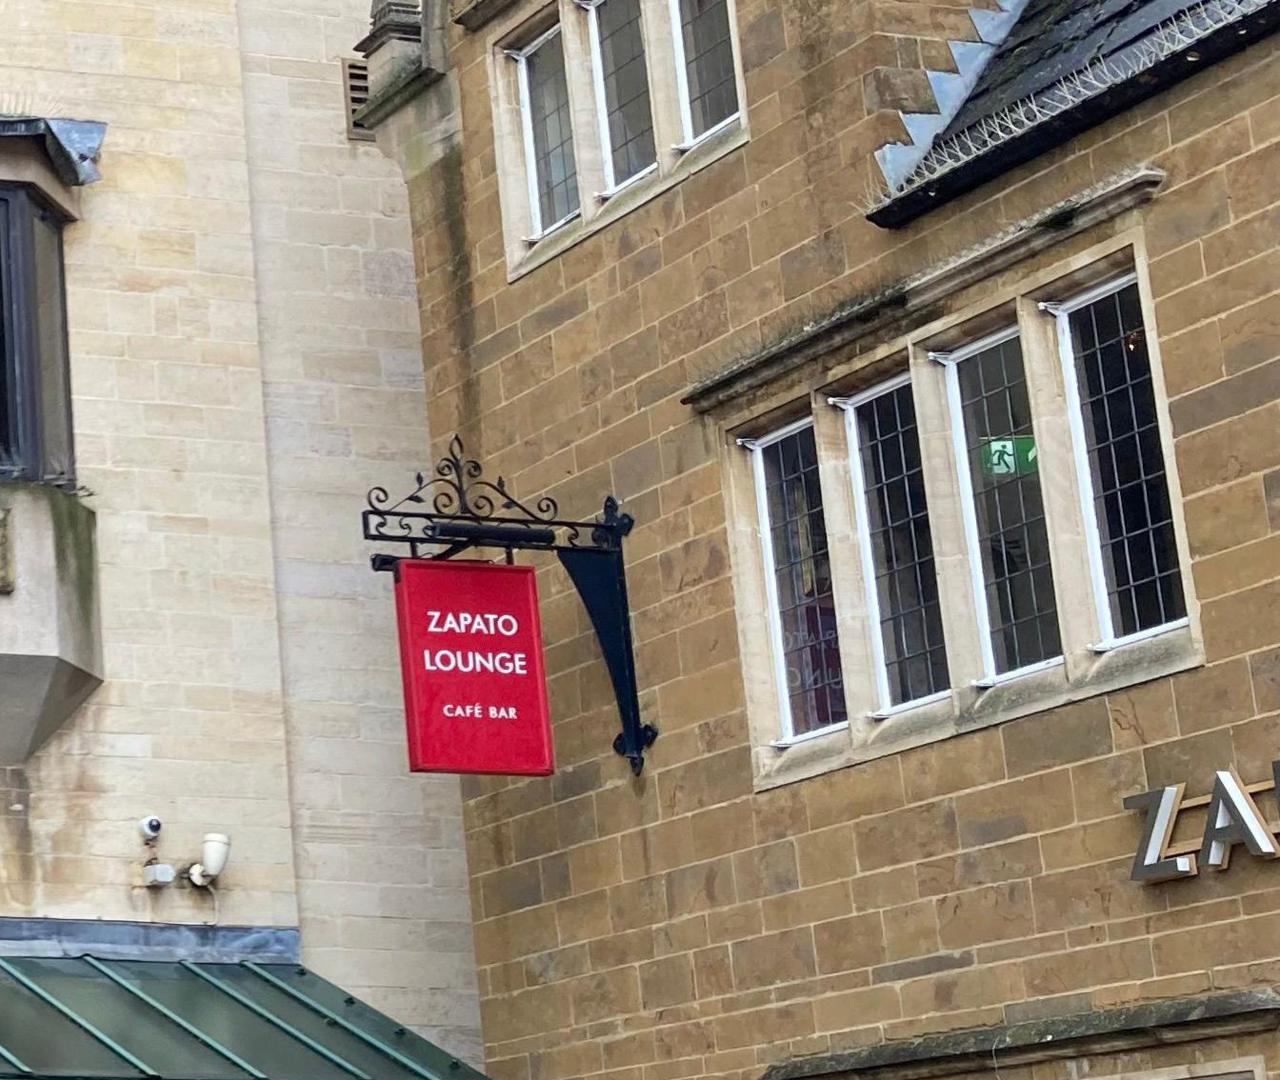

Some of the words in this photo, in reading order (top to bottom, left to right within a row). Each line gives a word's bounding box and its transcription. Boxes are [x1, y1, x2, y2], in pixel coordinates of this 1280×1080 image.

[426, 611, 518, 636] ZAPATO
[423, 649, 527, 674] LOUNGE
[443, 703, 483, 718] CAFÉ
[489, 706, 517, 719] BAR
[1123, 760, 1280, 882] ZA
